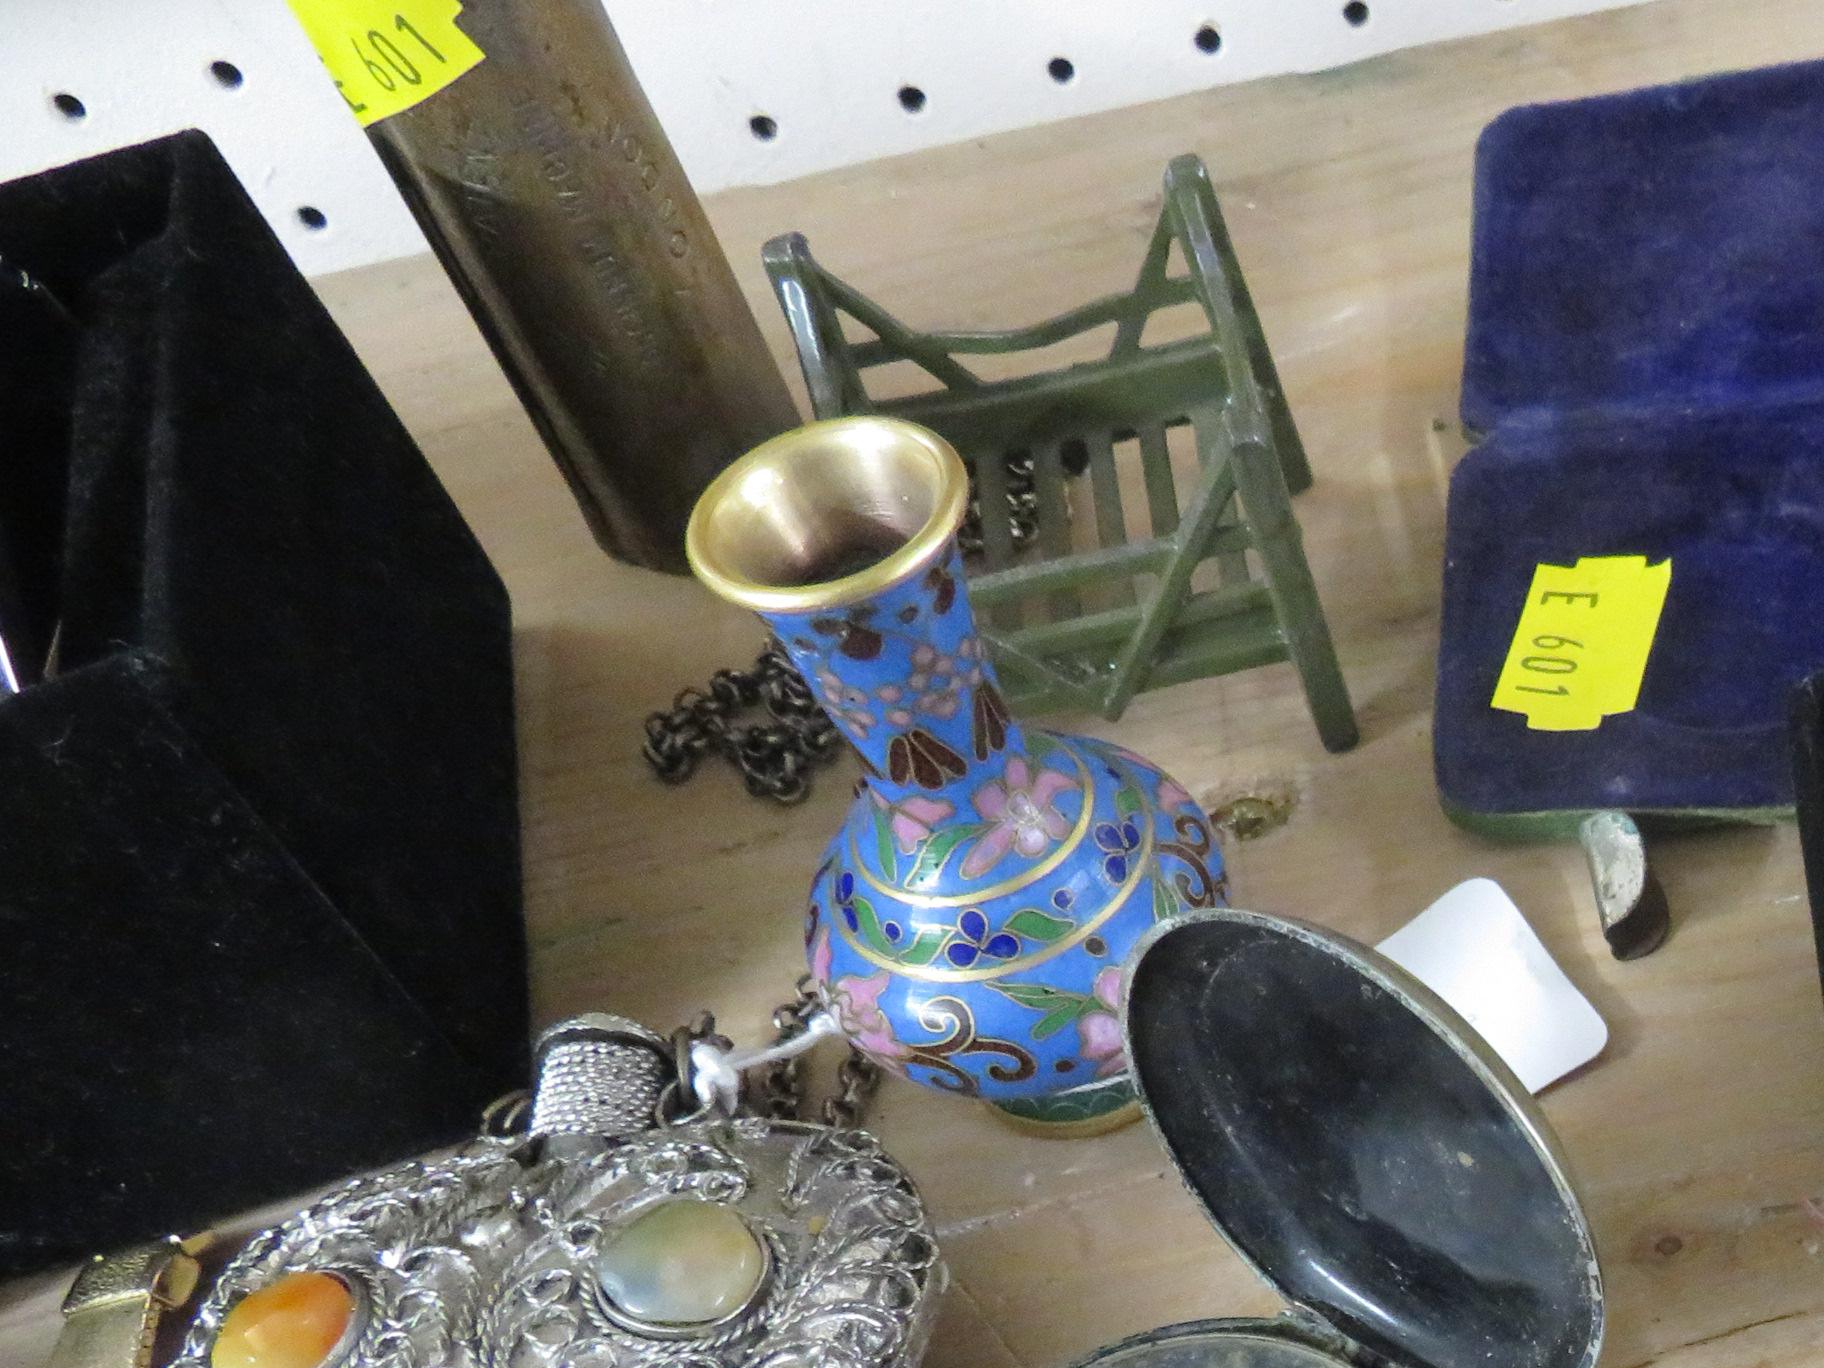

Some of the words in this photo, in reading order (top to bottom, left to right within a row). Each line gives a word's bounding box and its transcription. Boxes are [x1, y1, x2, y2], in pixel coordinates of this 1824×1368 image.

[350, 14, 447, 91] 601
[1540, 591, 1598, 608] E
[1515, 635, 1585, 695] 601
